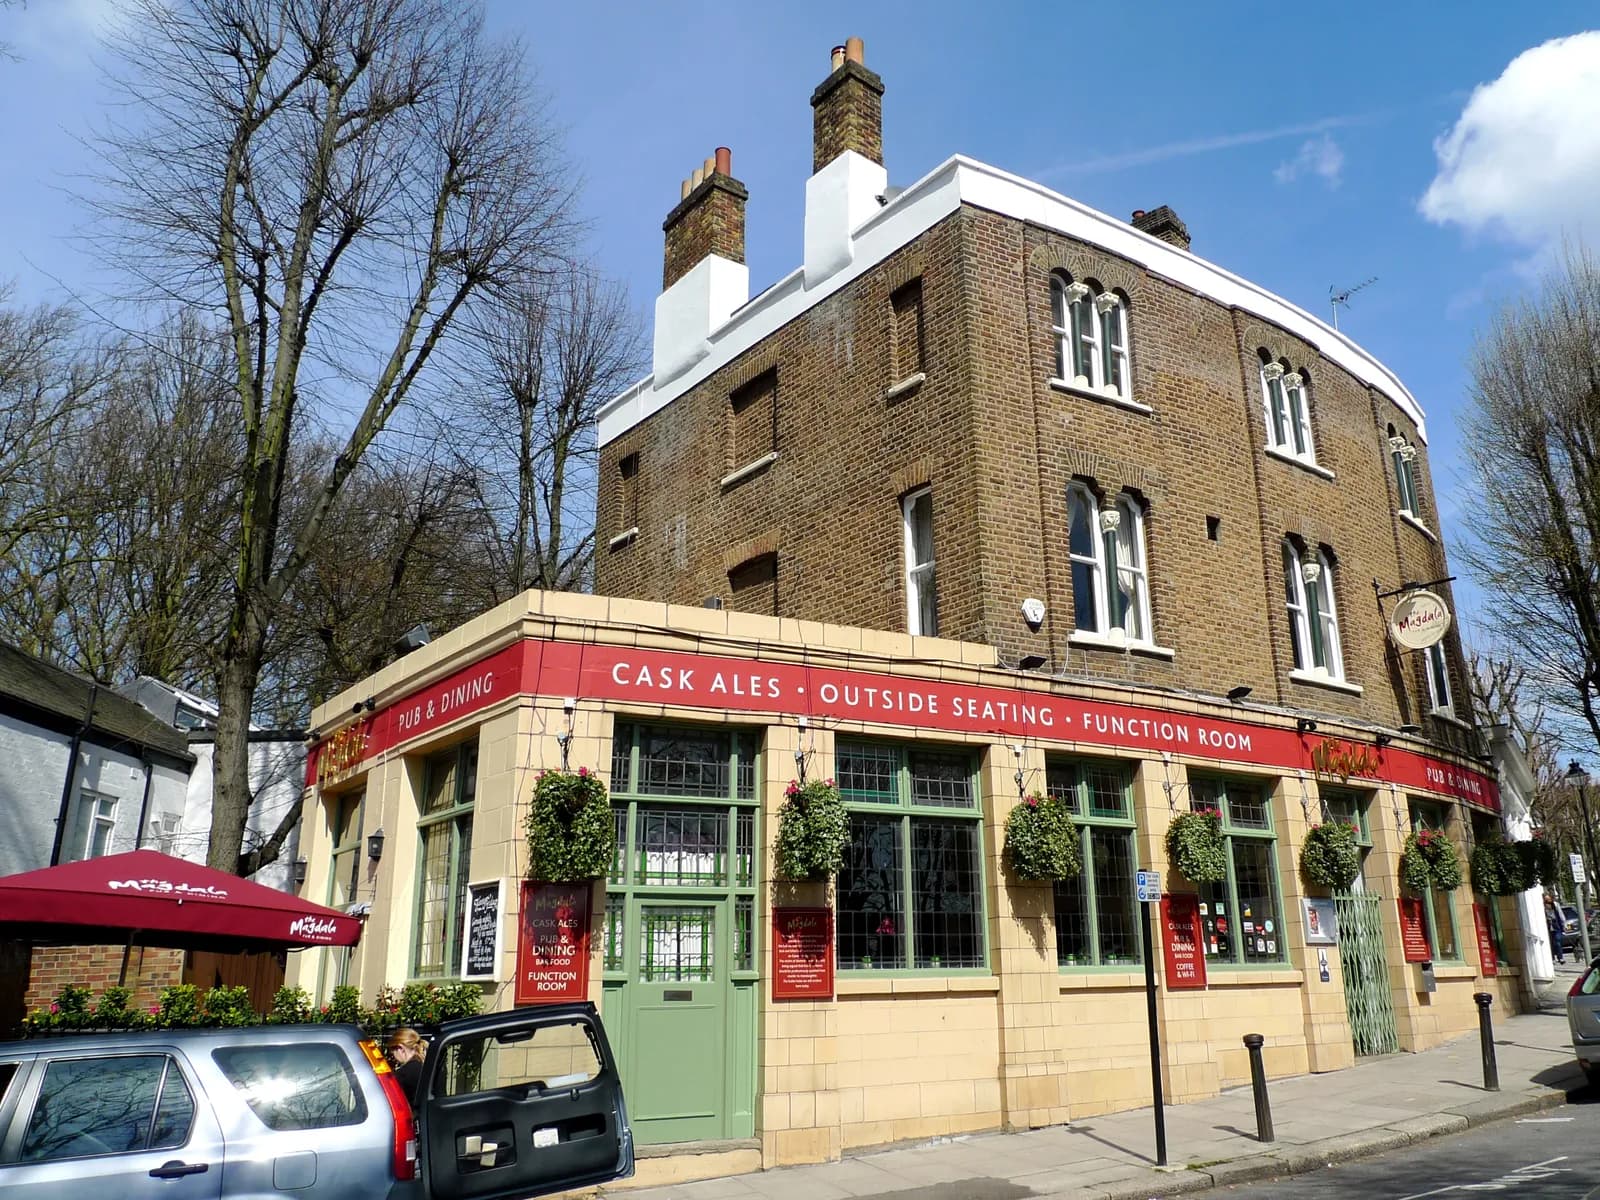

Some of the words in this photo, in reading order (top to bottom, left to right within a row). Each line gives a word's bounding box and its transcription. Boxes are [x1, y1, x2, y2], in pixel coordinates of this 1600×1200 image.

[1399, 606, 1442, 633] Magdala
[399, 706, 421, 733] PUB
[426, 700, 435, 719] &
[441, 672, 493, 713] DINING
[612, 662, 694, 690] CASK
[710, 672, 780, 698] ALES
[820, 683, 938, 714] OUTSIDE
[952, 697, 1053, 726] SEATING
[1083, 712, 1189, 742] FUNCTION
[1199, 728, 1252, 751] ROOM
[1426, 767, 1445, 784] PUB
[1448, 772, 1455, 786] &
[1456, 775, 1482, 795] DINING
[290, 918, 337, 935] Magdala
[532, 919, 556, 928] CASK
[557, 919, 578, 928] ALES
[540, 935, 558, 943] PUB
[560, 934, 569, 944] &
[532, 945, 576, 956] DINING
[1171, 943, 1195, 952] DINING
[535, 958, 549, 966] BAR
[550, 958, 571, 966] FOOD
[528, 971, 577, 981] FUNCTION
[537, 982, 567, 991] ROOM
